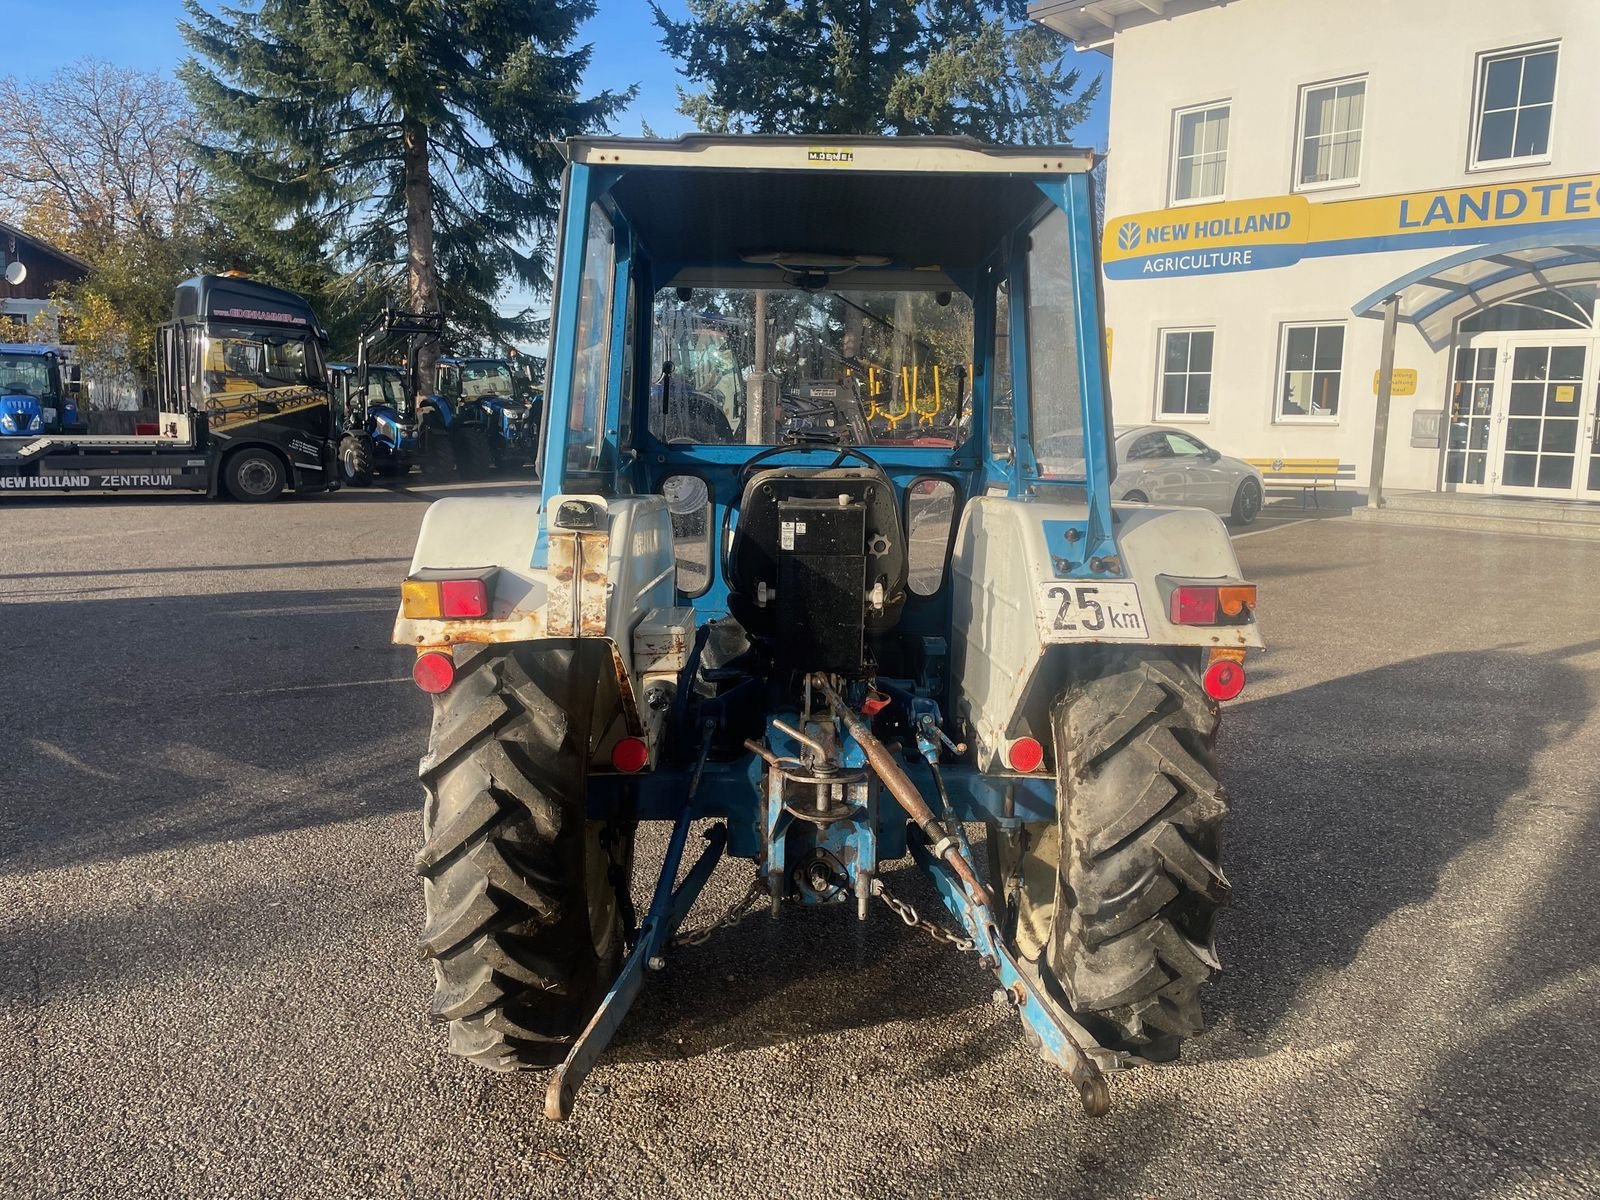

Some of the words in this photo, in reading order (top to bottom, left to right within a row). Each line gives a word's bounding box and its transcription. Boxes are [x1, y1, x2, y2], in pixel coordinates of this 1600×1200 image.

[1146, 222, 1191, 244] NEW
[1194, 211, 1291, 239] HOLLAND
[1143, 250, 1252, 273] AGRICULTURE
[0, 476, 27, 488] NEW
[29, 475, 90, 488] HOLLAND
[101, 475, 173, 487] ZENTRUM
[1048, 587, 1106, 631] 25
[1107, 606, 1141, 629] km
